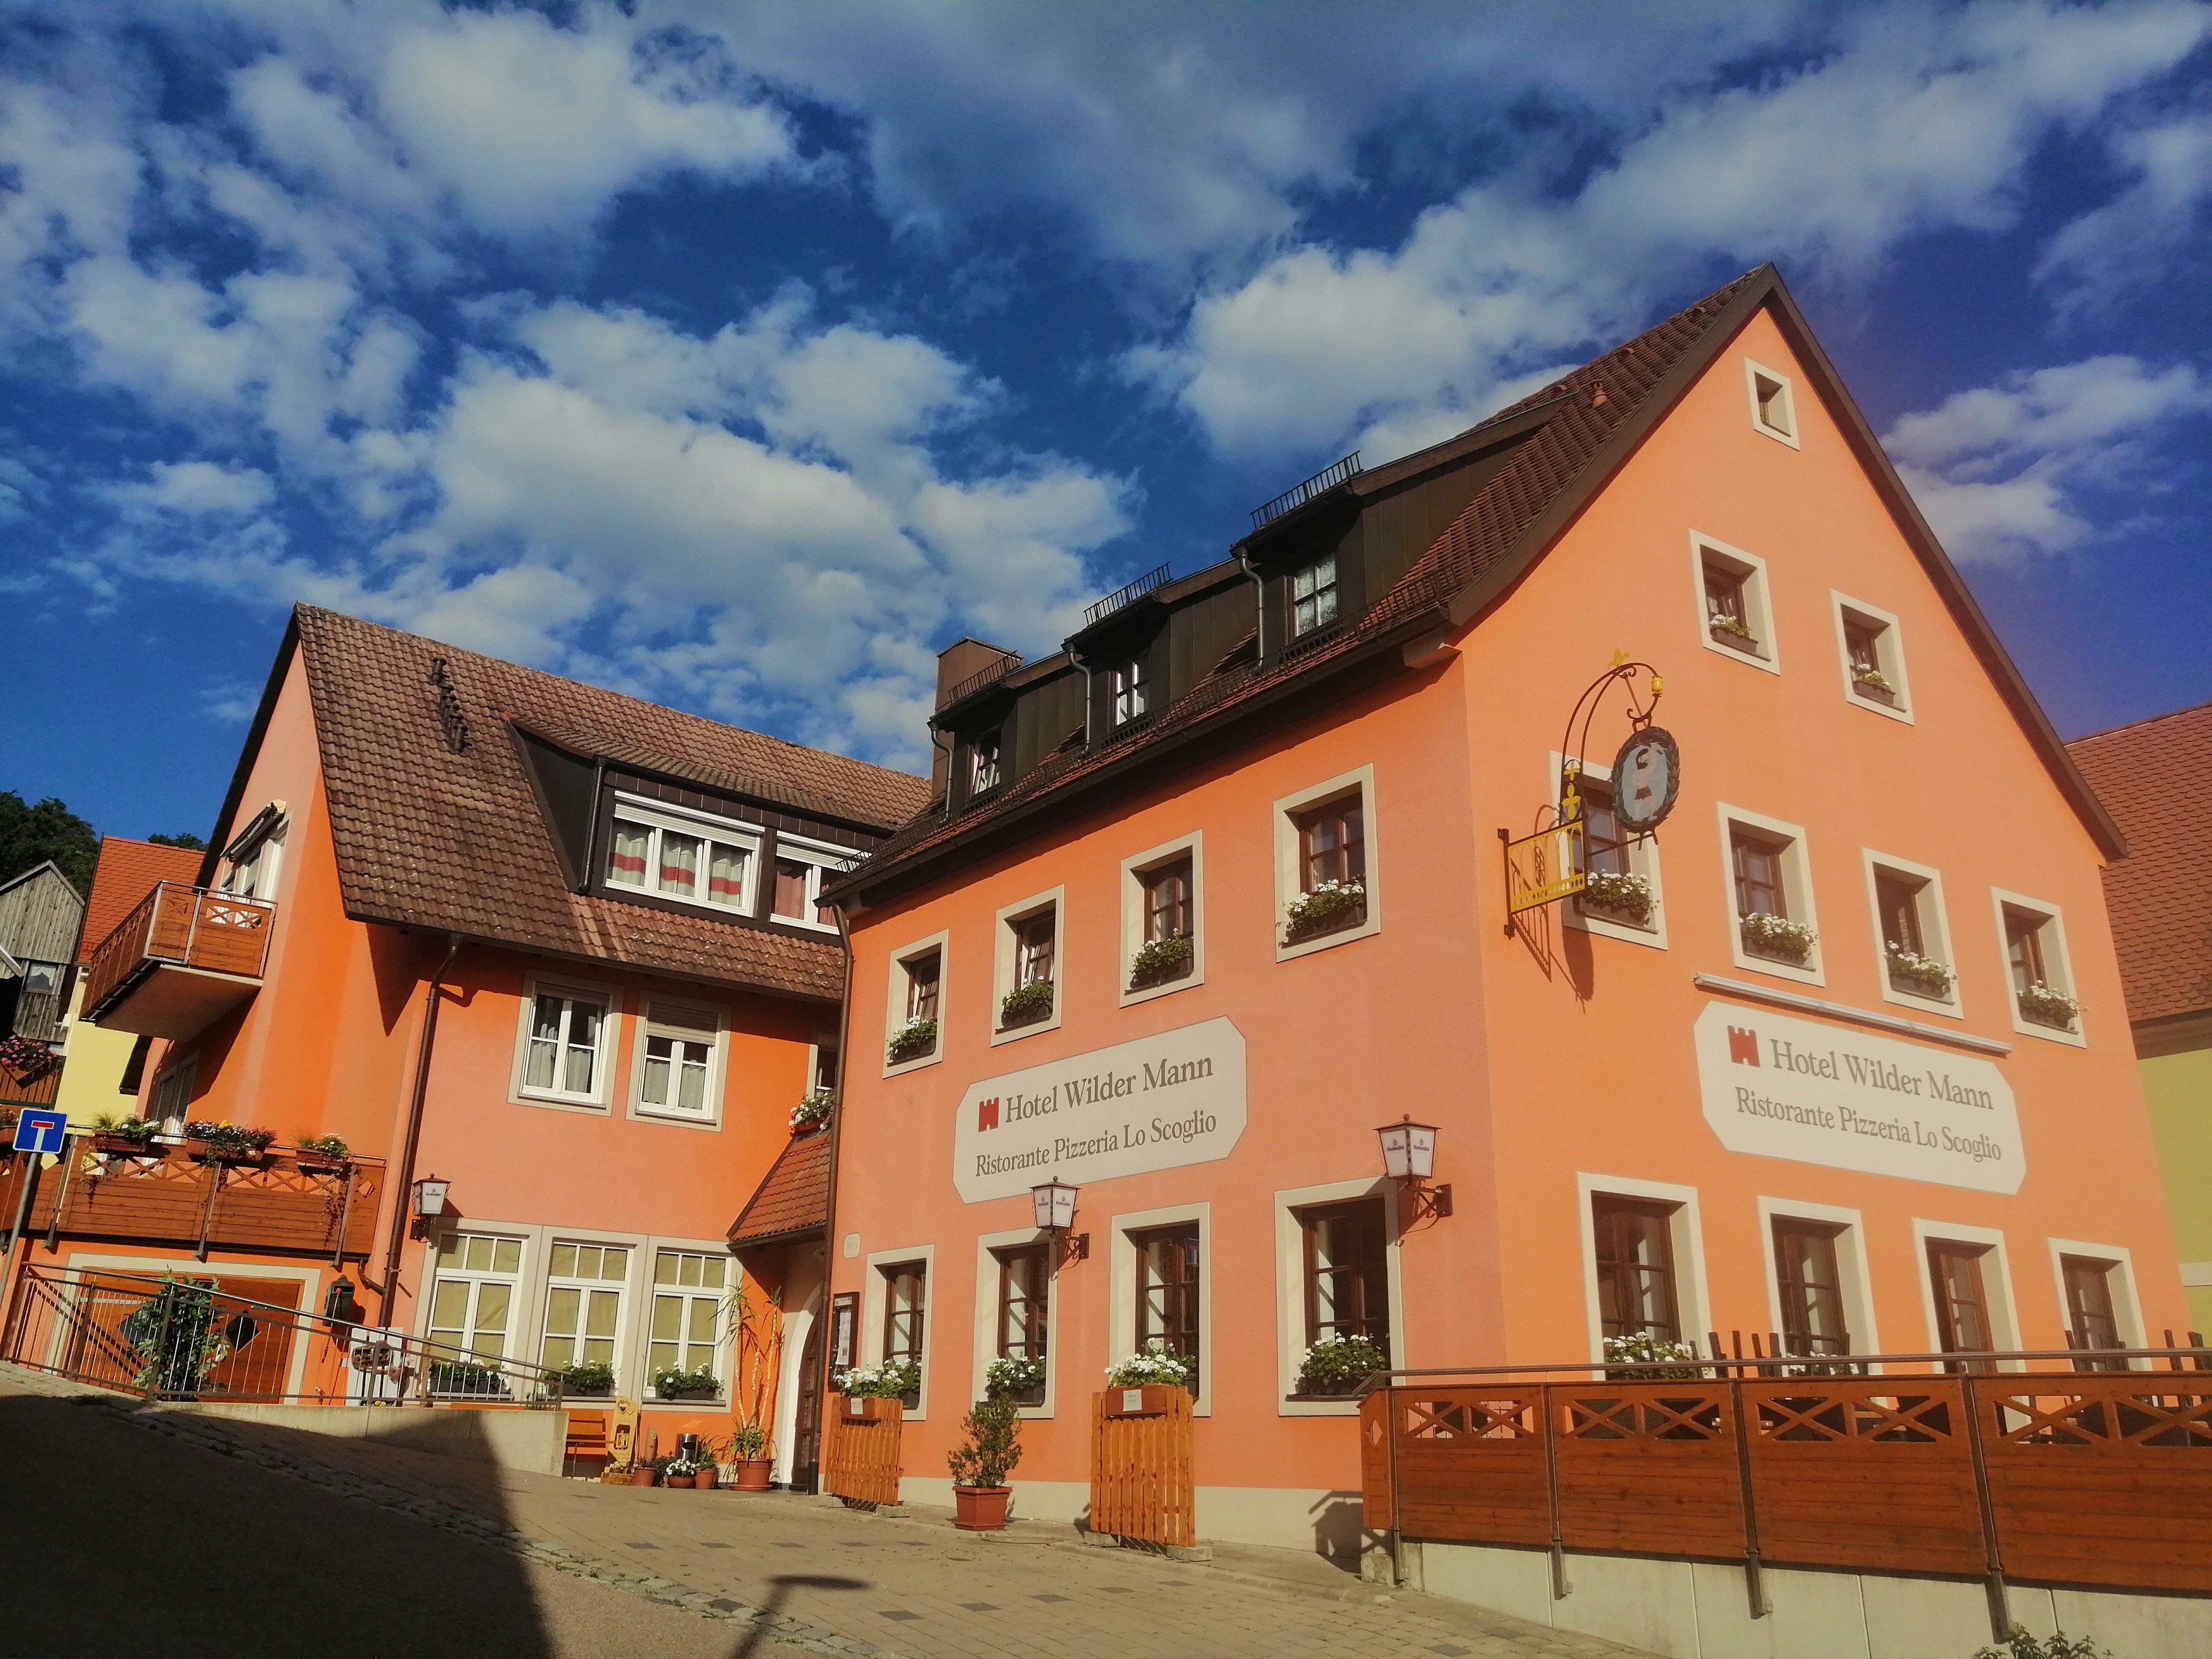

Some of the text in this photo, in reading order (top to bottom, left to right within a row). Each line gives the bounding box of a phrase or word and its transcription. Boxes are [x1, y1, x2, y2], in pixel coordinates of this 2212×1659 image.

[1006, 1057, 1214, 1123] Hotel Wilder Mann
[1770, 1039, 1994, 1110] Hotel Wilder Mann
[976, 1109, 1217, 1177] Ristorante Pizzeria Lo Scoglio
[1735, 1086, 2001, 1163] Ristorante Pizzeria Lo Scoglio
